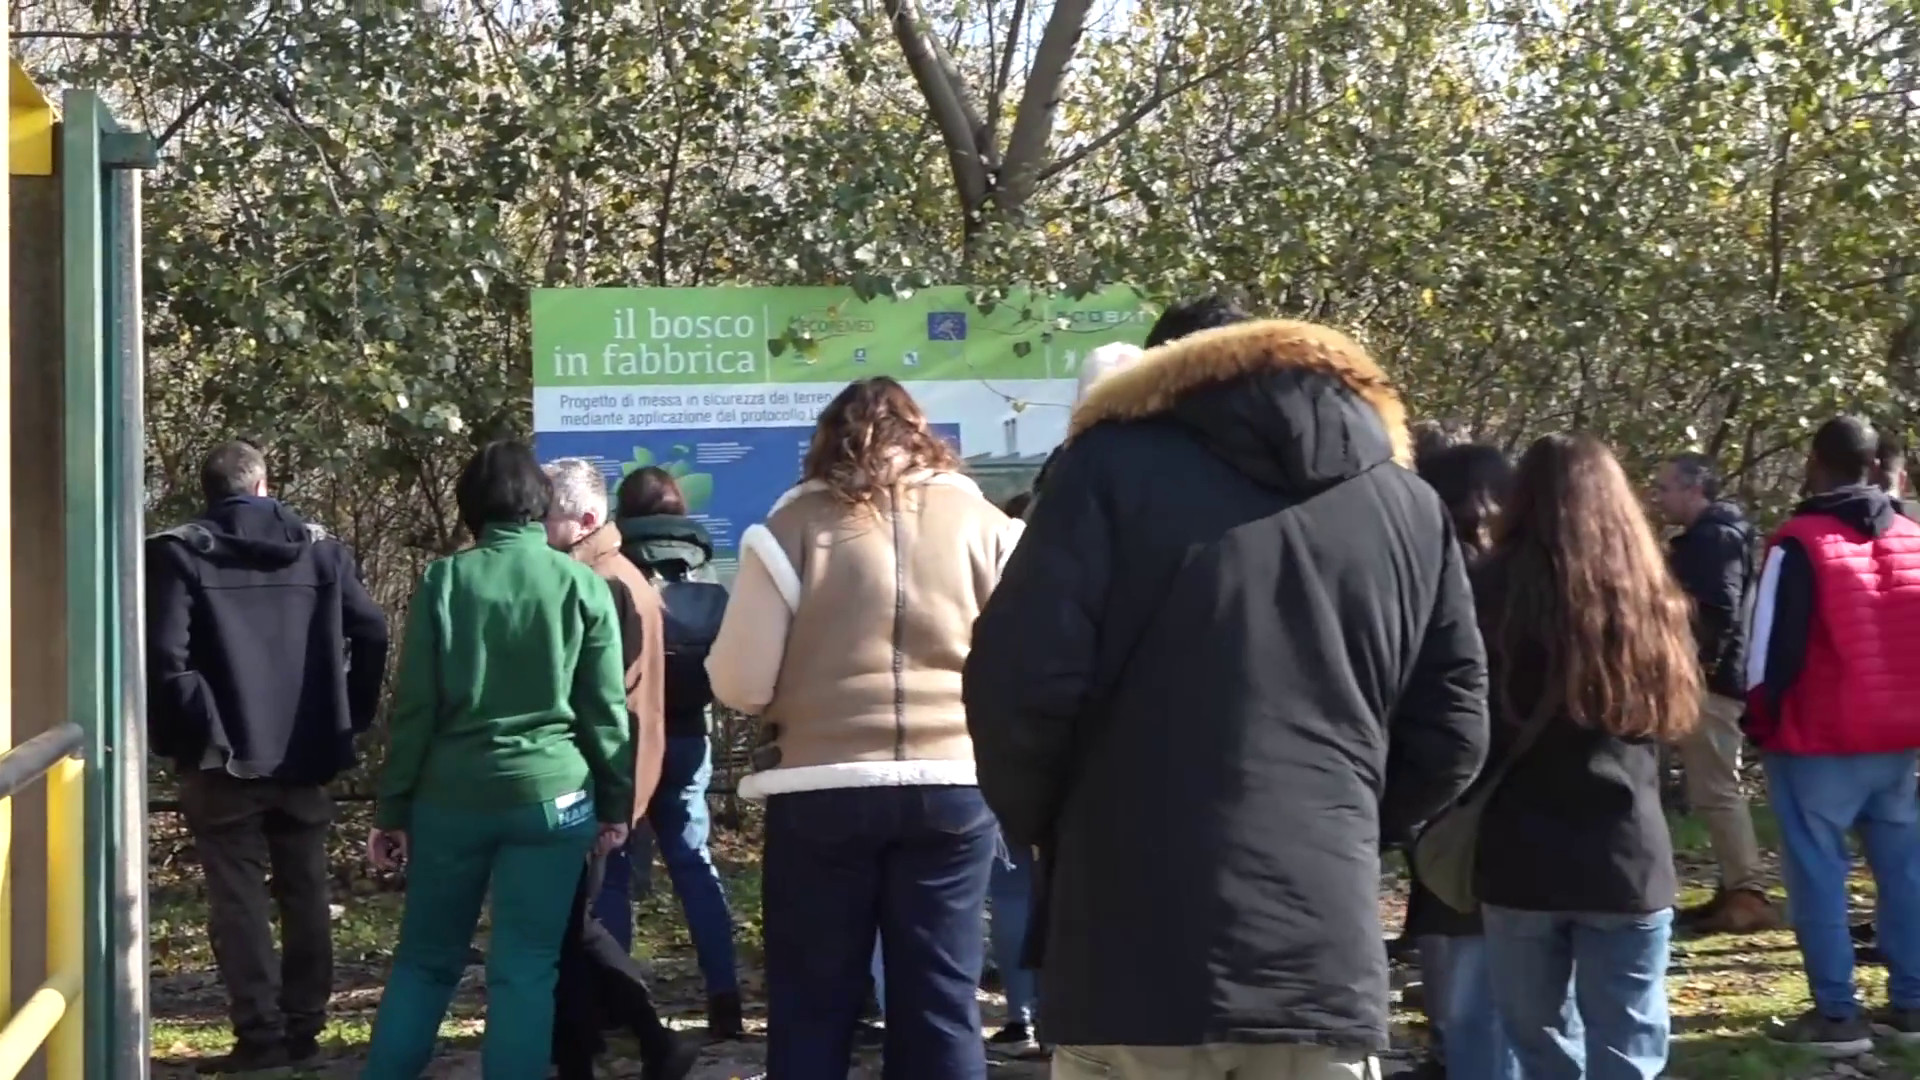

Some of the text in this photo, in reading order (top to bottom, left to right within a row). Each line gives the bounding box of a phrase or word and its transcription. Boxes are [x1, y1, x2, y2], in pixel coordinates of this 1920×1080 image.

[613, 307, 755, 340] il bosco
[553, 343, 756, 377] in fabbrica
[560, 391, 834, 411] Progetto di messa in sicurezza dei terren
[560, 411, 623, 426] mediante
[628, 409, 712, 427] applicazione
[716, 408, 736, 423] del
[741, 407, 806, 425] protocollo
